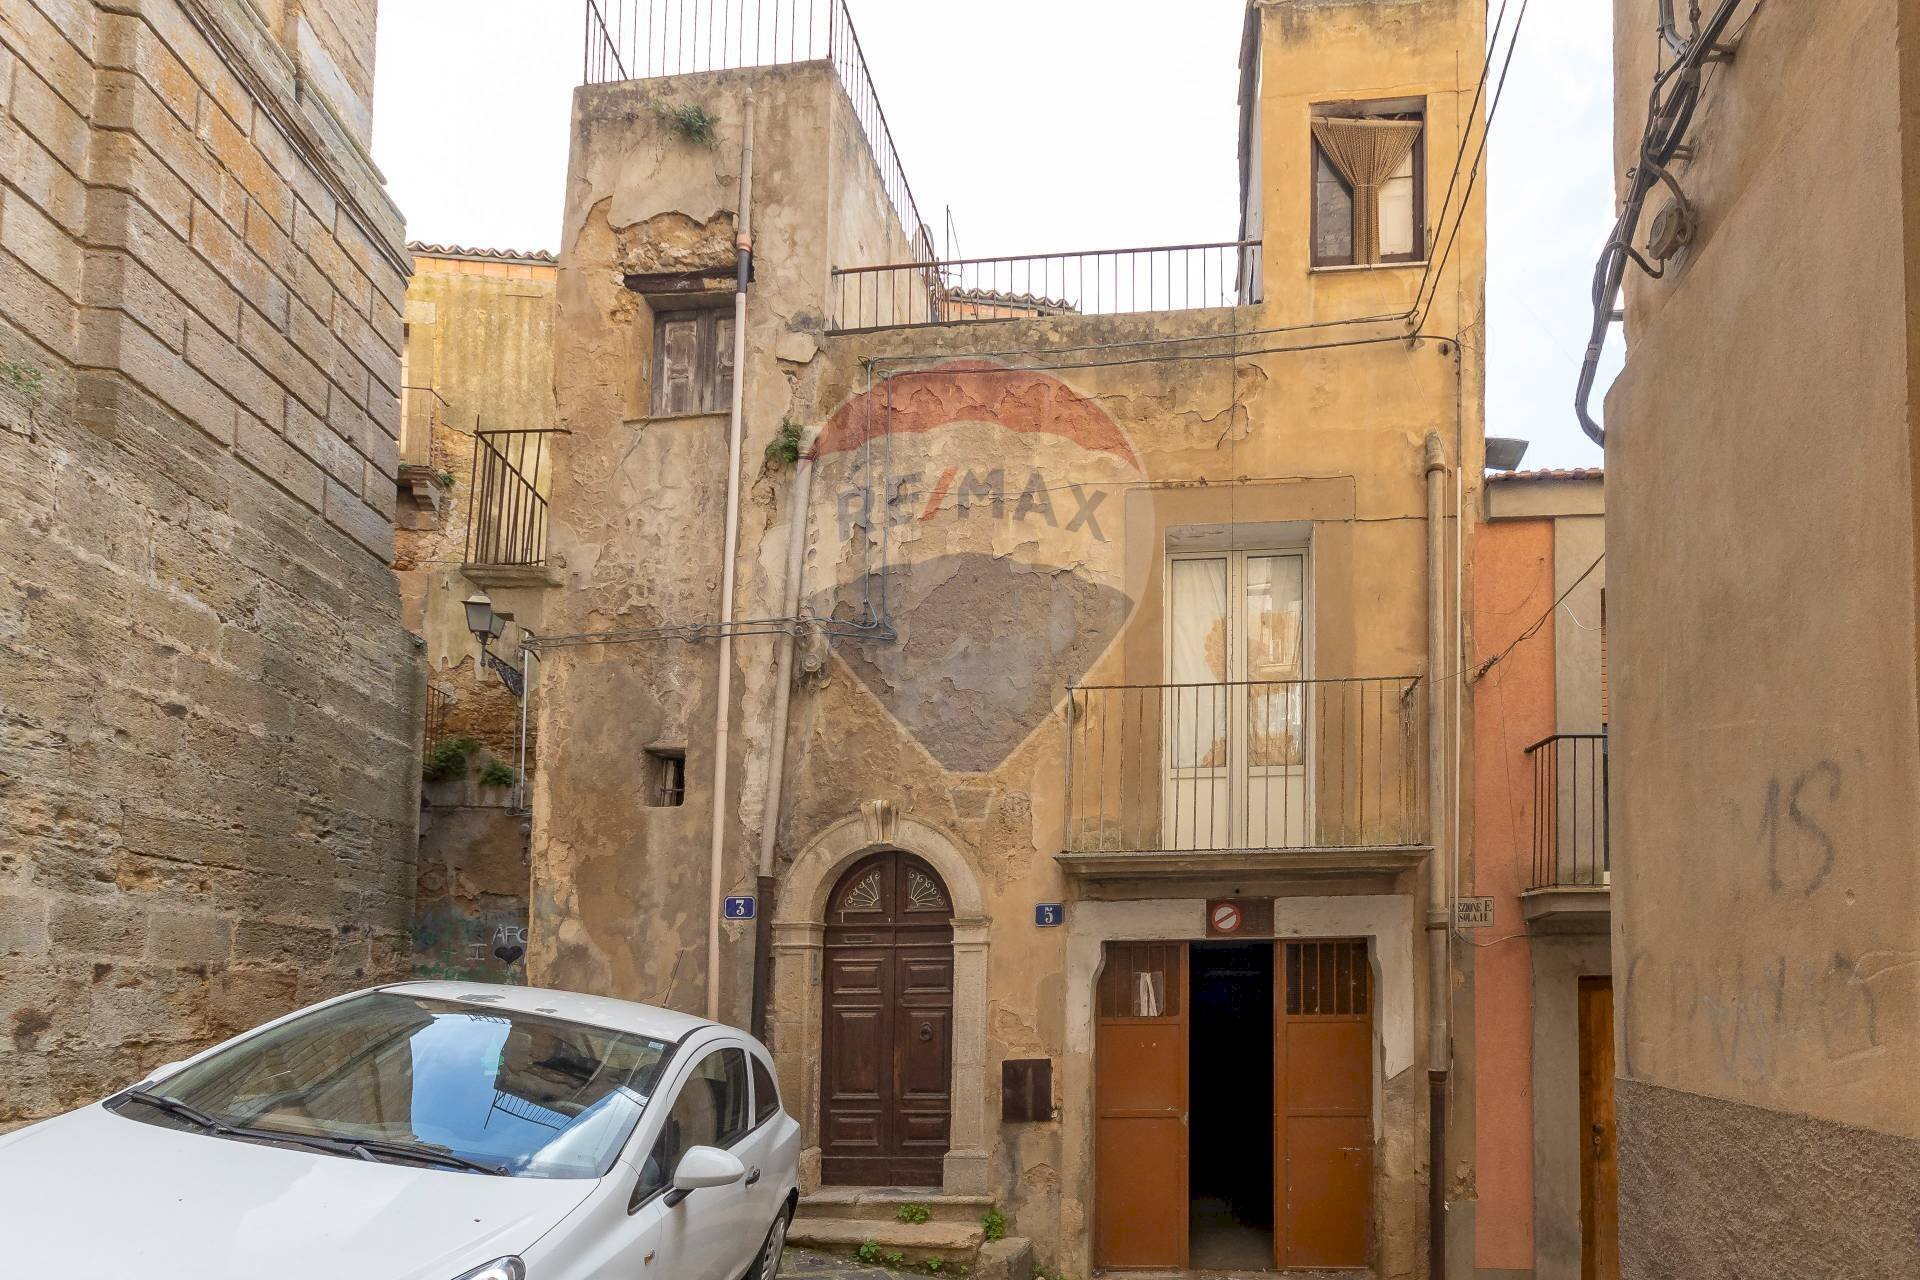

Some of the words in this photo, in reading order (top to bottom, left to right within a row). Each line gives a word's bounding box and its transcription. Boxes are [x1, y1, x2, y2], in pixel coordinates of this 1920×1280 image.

[735, 899, 745, 916] 3
[1452, 902, 1482, 913] EZIONE
[1484, 899, 1493, 912] E
[1044, 906, 1054, 924] 5
